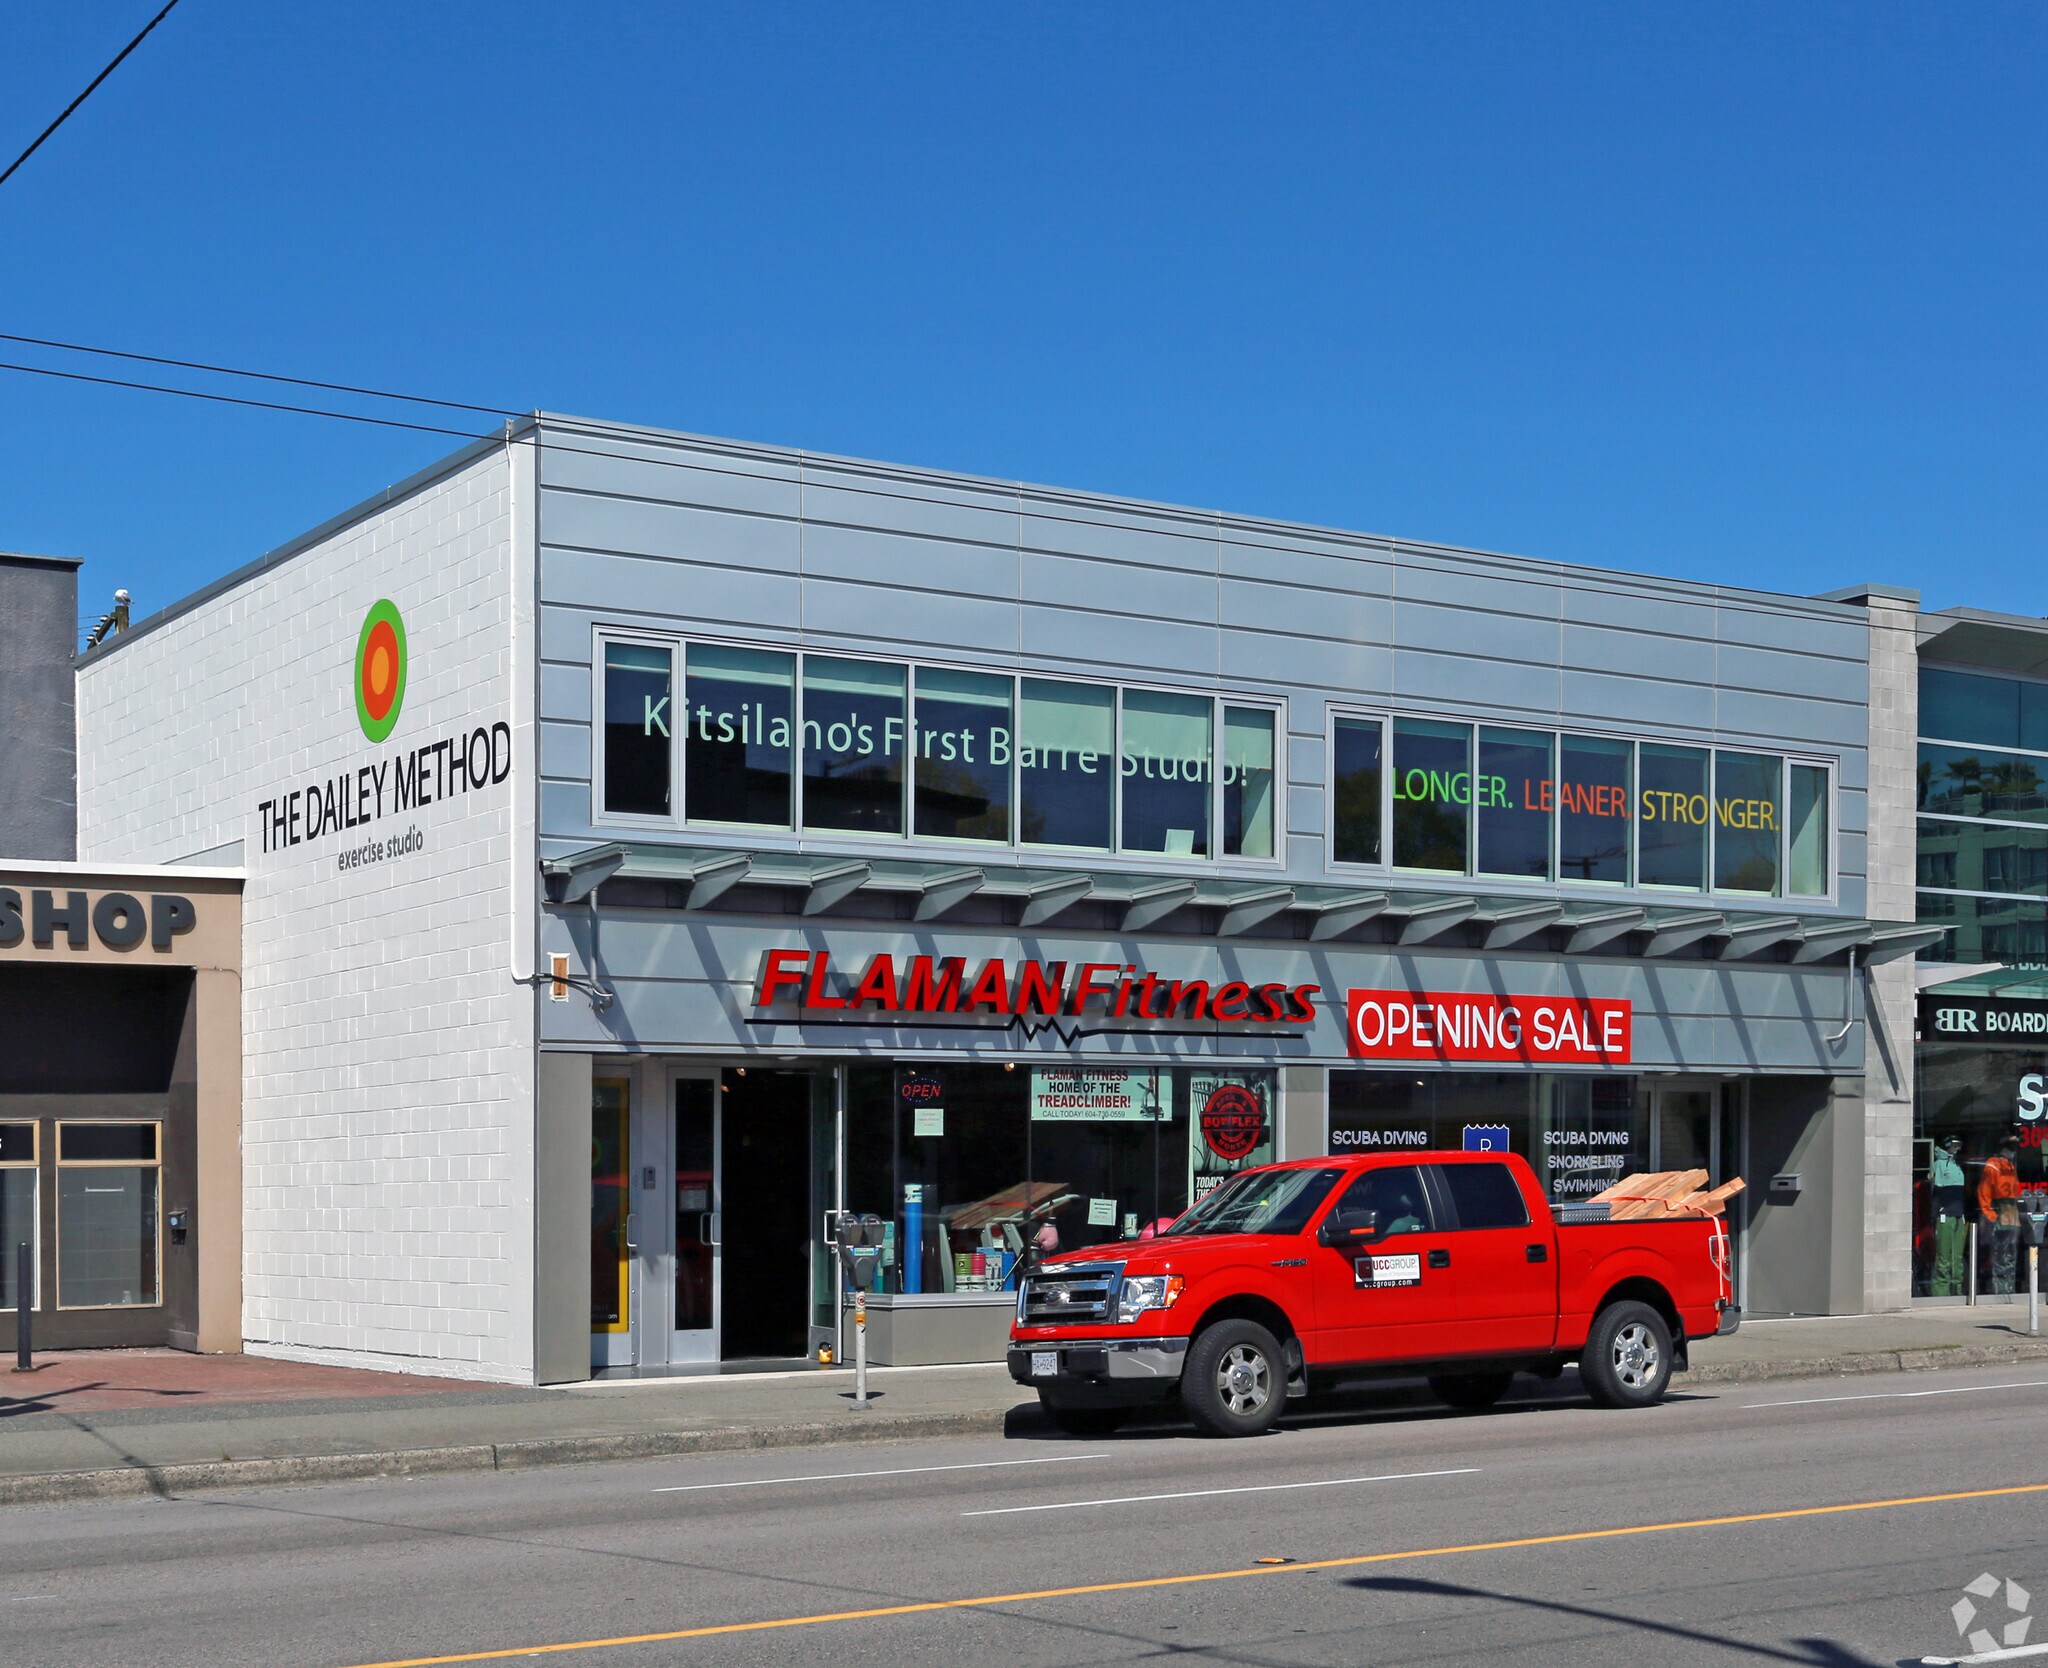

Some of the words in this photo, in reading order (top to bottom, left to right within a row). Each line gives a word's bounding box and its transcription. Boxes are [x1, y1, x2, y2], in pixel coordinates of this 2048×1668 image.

[644, 695, 874, 755] Kitsilano's
[884, 716, 975, 763] First
[990, 726, 1099, 774] Barre
[1121, 740, 1247, 787] Studio!
[258, 790, 301, 853] THE
[306, 760, 388, 841] DAILEY
[394, 721, 511, 814] METHOD
[1392, 767, 1514, 809] LONGER.
[1524, 779, 1632, 818] LEANER.
[1642, 790, 1780, 831] STRONGER.
[338, 837, 384, 871] exercise
[386, 824, 424, 859] studio
[756, 948, 1068, 1015] FLAMAN
[1066, 962, 1322, 1023] Fitness
[1356, 1000, 1522, 1050] OPENING
[1533, 1007, 1624, 1053] SALE
[1986, 1010, 2048, 1033] BOARD
[1041, 1068, 1083, 1080] FLAMAN
[1086, 1069, 1129, 1081] FITNESS
[901, 1084, 942, 1097] OPEN
[1049, 1081, 1080, 1093] HOME
[1082, 1082, 1097, 1094] OF
[1099, 1082, 1121, 1094] THE
[1037, 1094, 1131, 1109] TREADCLIMBER!
[2018, 1073, 2048, 1121] S
[1042, 1110, 1059, 1118] CALL
[1060, 1110, 1084, 1118] TODAY!
[1203, 1116, 1260, 1128] BOWFLEX
[1332, 1130, 1381, 1145] SCUBA
[1383, 1131, 1428, 1145] DIVING
[1543, 1131, 1587, 1145] SCUBA
[1589, 1131, 1629, 1145] DIVING
[1547, 1155, 1625, 1169] SNORKELING
